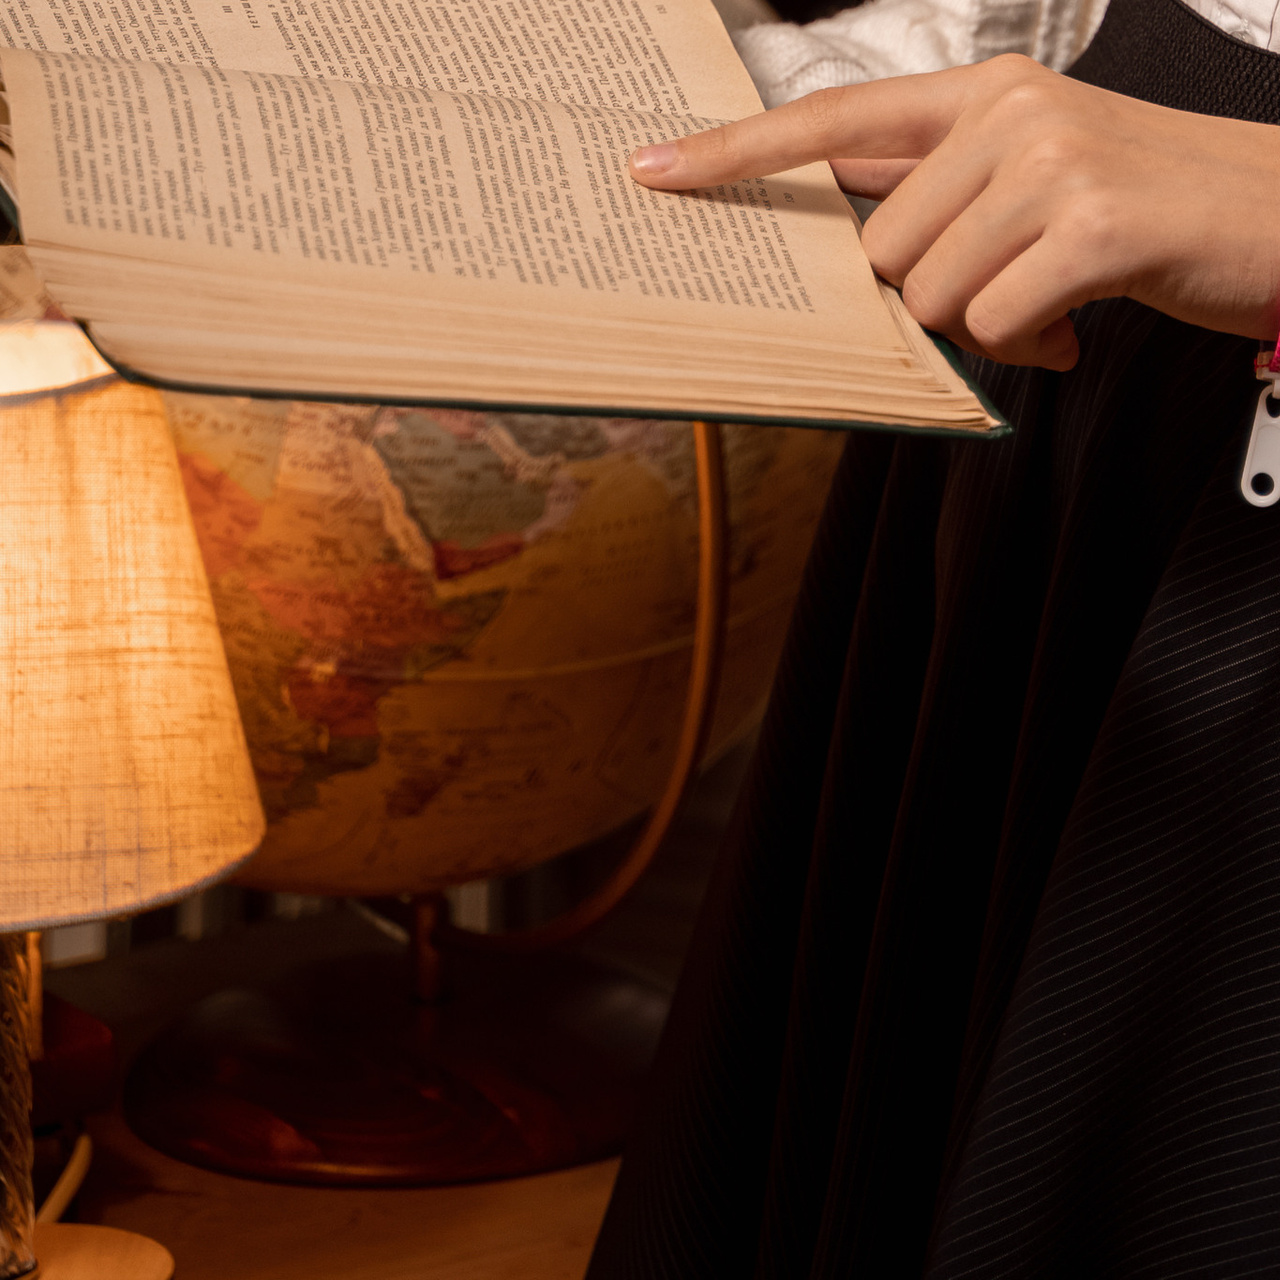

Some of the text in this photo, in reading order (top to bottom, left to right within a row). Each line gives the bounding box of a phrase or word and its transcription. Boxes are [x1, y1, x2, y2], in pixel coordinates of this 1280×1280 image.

[91, 1, 107, 19] после
[147, 0, 164, 15] Иван
[23, 13, 37, 28] рода
[52, 12, 67, 29] занят
[76, 0, 100, 36] состоявшая
[108, 6, 127, 31] тетушка
[141, 12, 161, 41] тетушка,
[60, 32, 75, 44] был
[68, 18, 87, 40] собака
[163, 28, 179, 46] здесь.
[178, 27, 190, 38] как
[189, 22, 213, 54] дряхлости
[121, 33, 133, 44] что
[134, 29, 153, 54] кучером
[174, 49, 187, 62] уже
[183, 38, 200, 59] руках,
